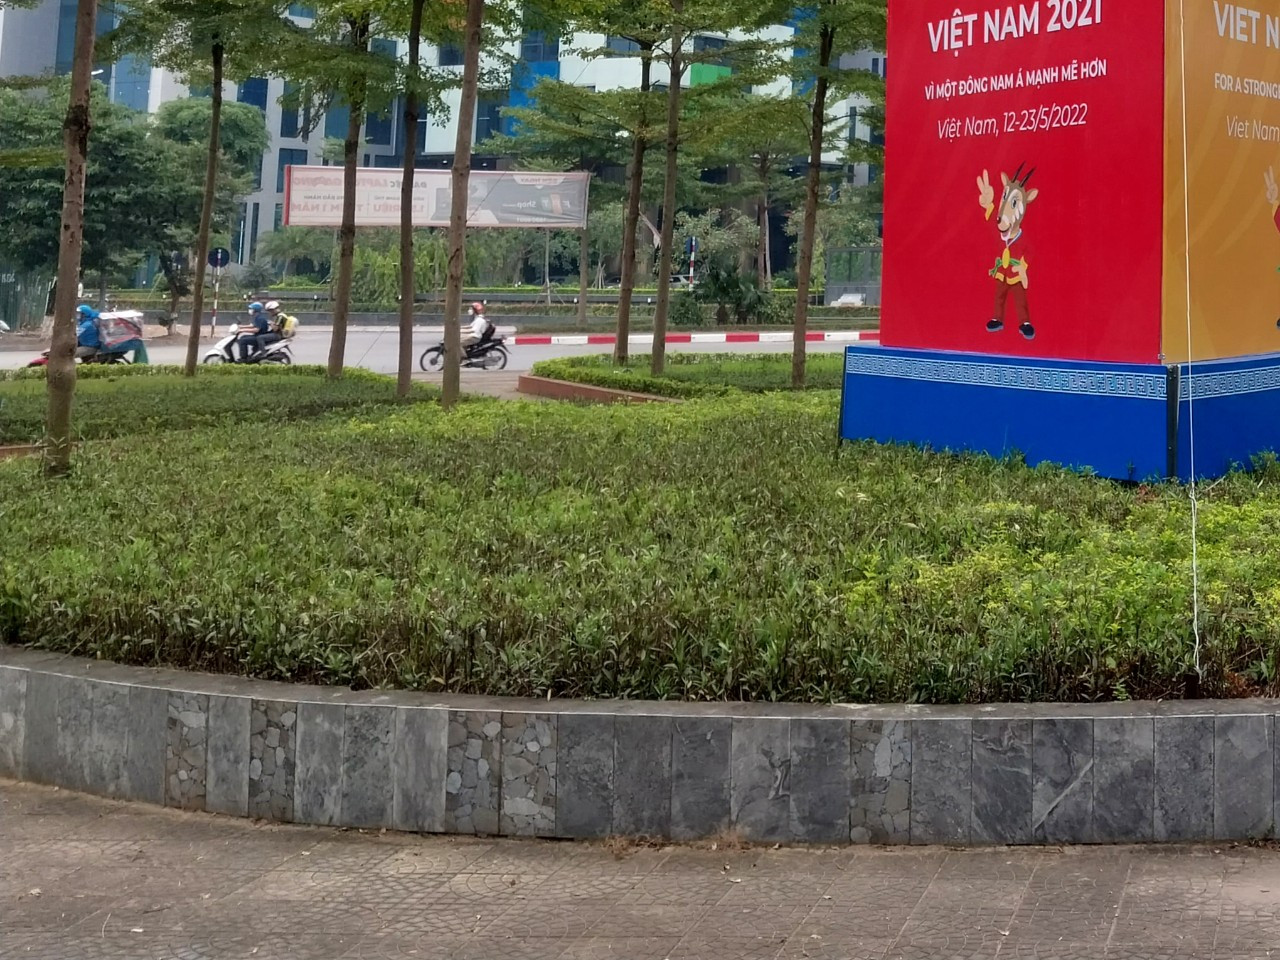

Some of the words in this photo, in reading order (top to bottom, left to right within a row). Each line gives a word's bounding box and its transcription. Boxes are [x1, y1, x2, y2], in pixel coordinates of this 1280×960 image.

[927, 7, 977, 58] VIỆT
[983, 0, 1040, 44] NAM
[1213, 0, 1261, 44] VIET
[924, 81, 935, 101] VÌ
[935, 78, 958, 102] MỘT
[958, 74, 989, 96] ĐÔNG
[989, 72, 1015, 92] NAM
[1015, 67, 1025, 88] Á
[1025, 66, 1059, 90] MẠNH
[1060, 59, 1079, 82] MẼ
[1080, 57, 1107, 80] HƠN
[1214, 72, 1234, 92] FOR
[1234, 77, 1243, 93] A
[937, 116, 962, 143] Việt
[963, 115, 1001, 137] Nam,
[1002, 102, 1089, 133] 12-23/5/2022
[1227, 115, 1250, 139] Viet
